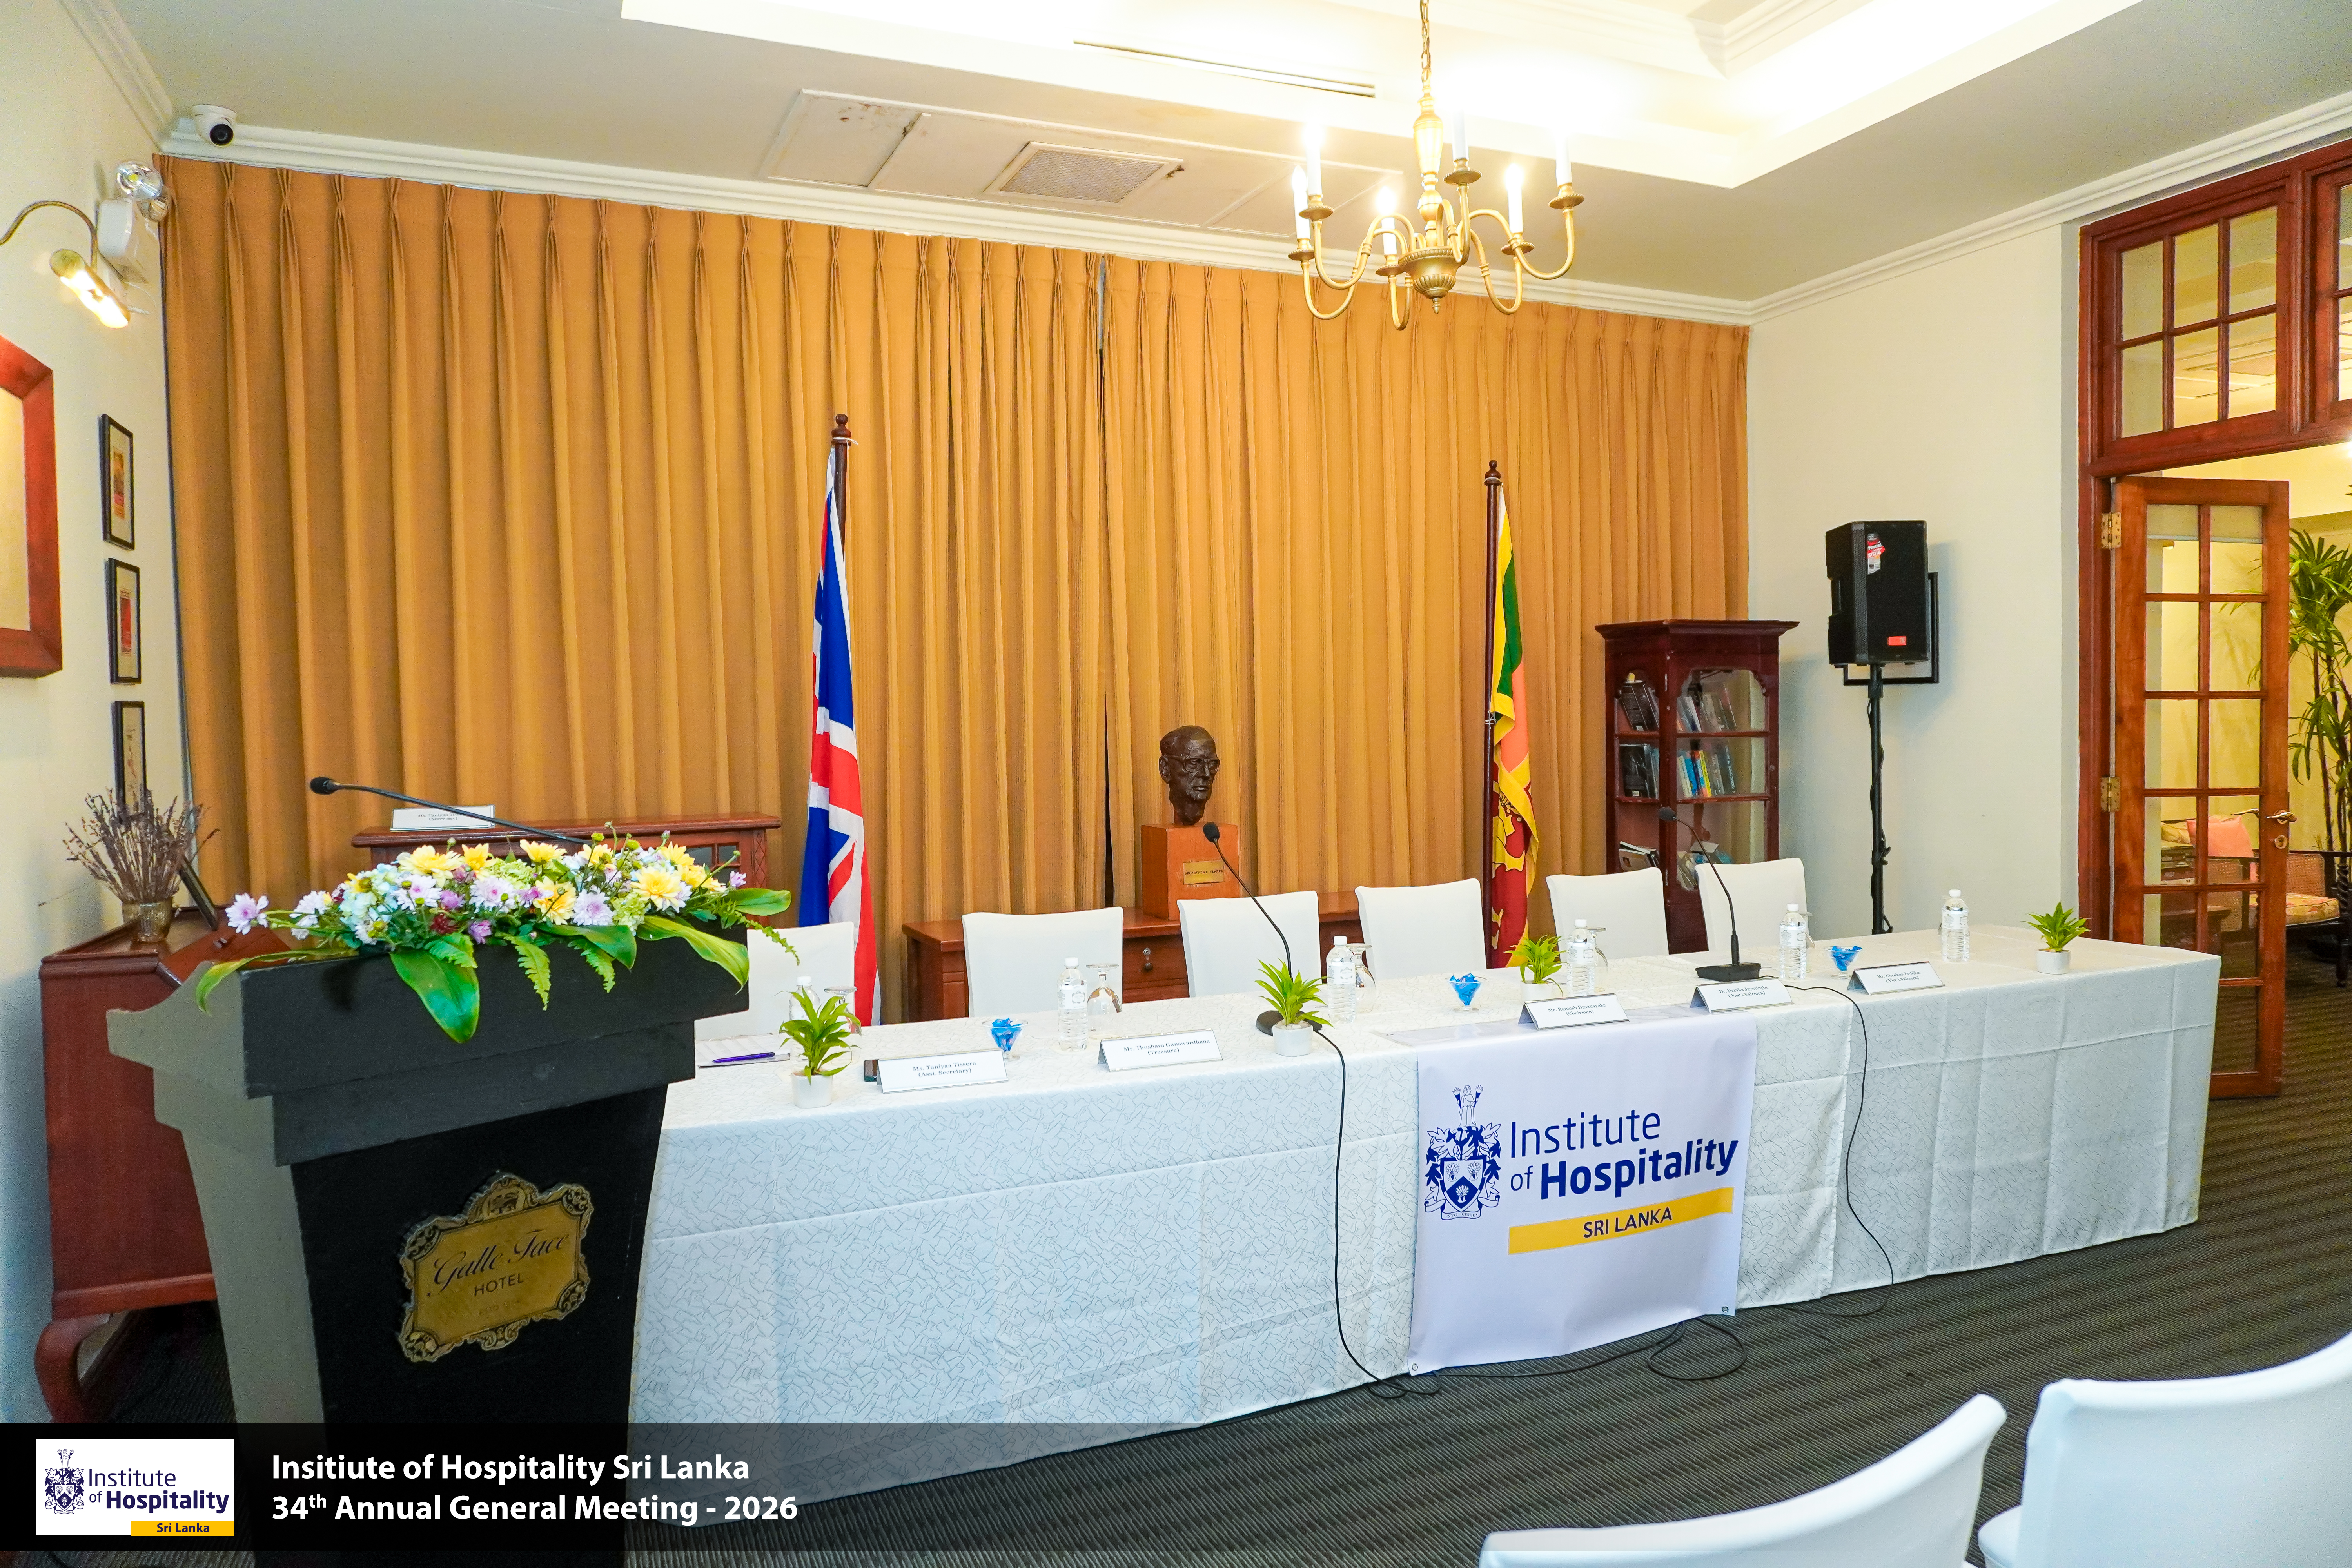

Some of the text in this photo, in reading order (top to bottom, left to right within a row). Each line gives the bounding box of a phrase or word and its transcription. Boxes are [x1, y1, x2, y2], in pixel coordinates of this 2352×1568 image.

[1511, 1109, 1661, 1158] Institute
[1510, 1138, 1739, 1200] of Hospitality
[1583, 1206, 1672, 1238] SRI LANKA
[474, 1272, 525, 1297] HOTEL
